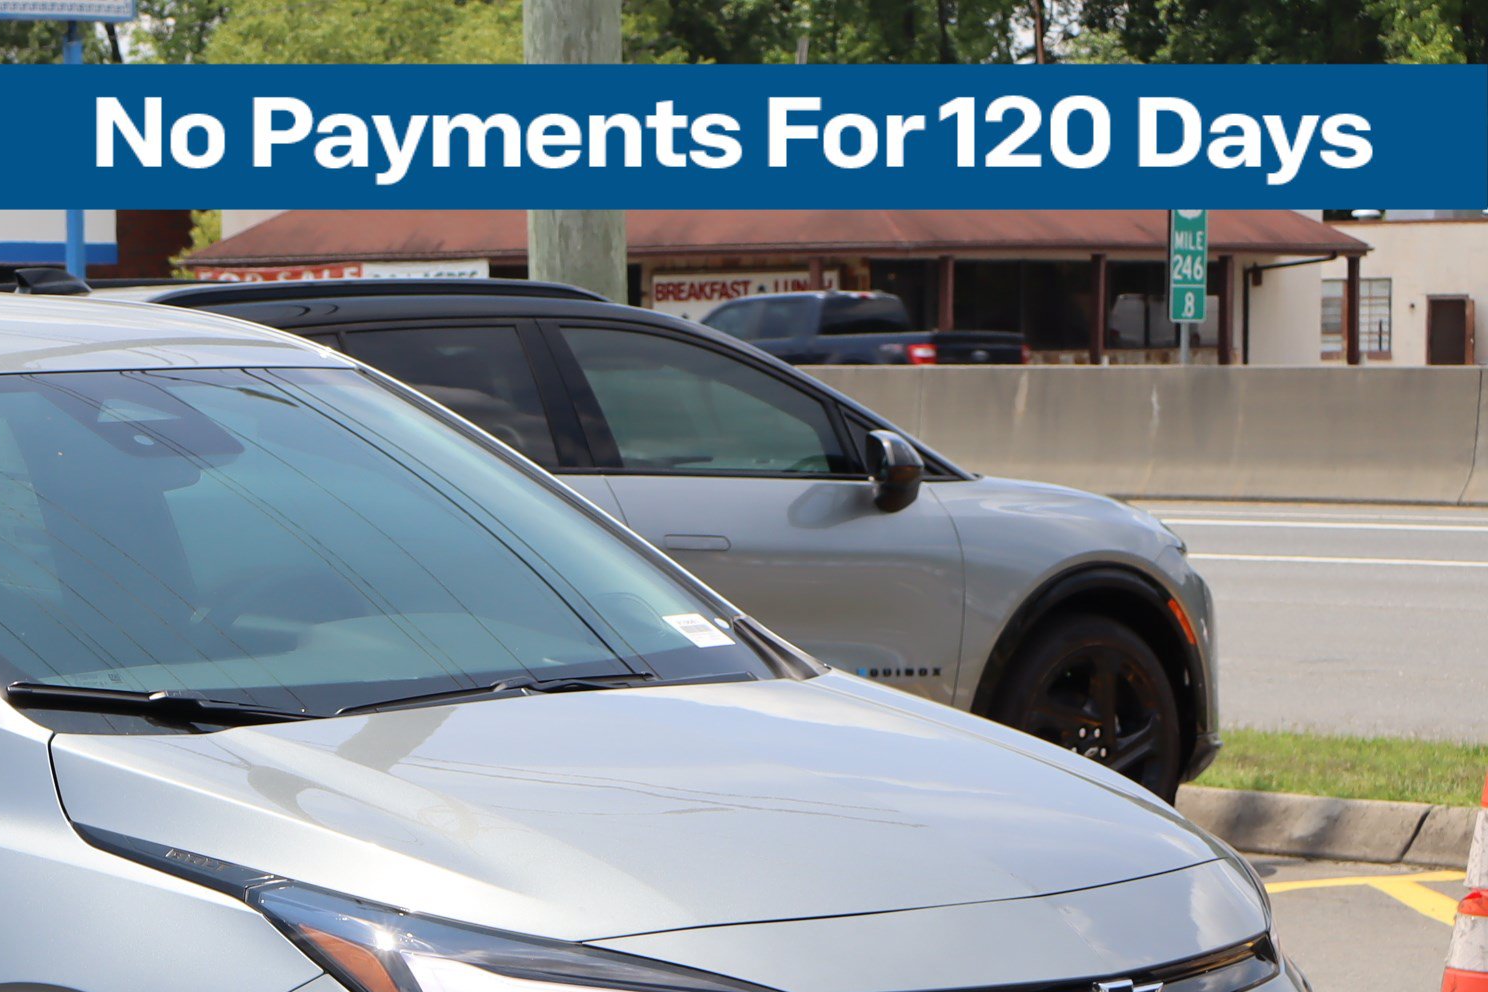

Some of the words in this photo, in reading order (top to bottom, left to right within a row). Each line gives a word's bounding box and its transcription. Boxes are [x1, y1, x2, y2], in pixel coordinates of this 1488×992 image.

[1174, 230, 1204, 250] MILE
[1172, 254, 1204, 280] 246
[655, 280, 751, 301] BREAKFAST
[774, 278, 833, 293] LUNH
